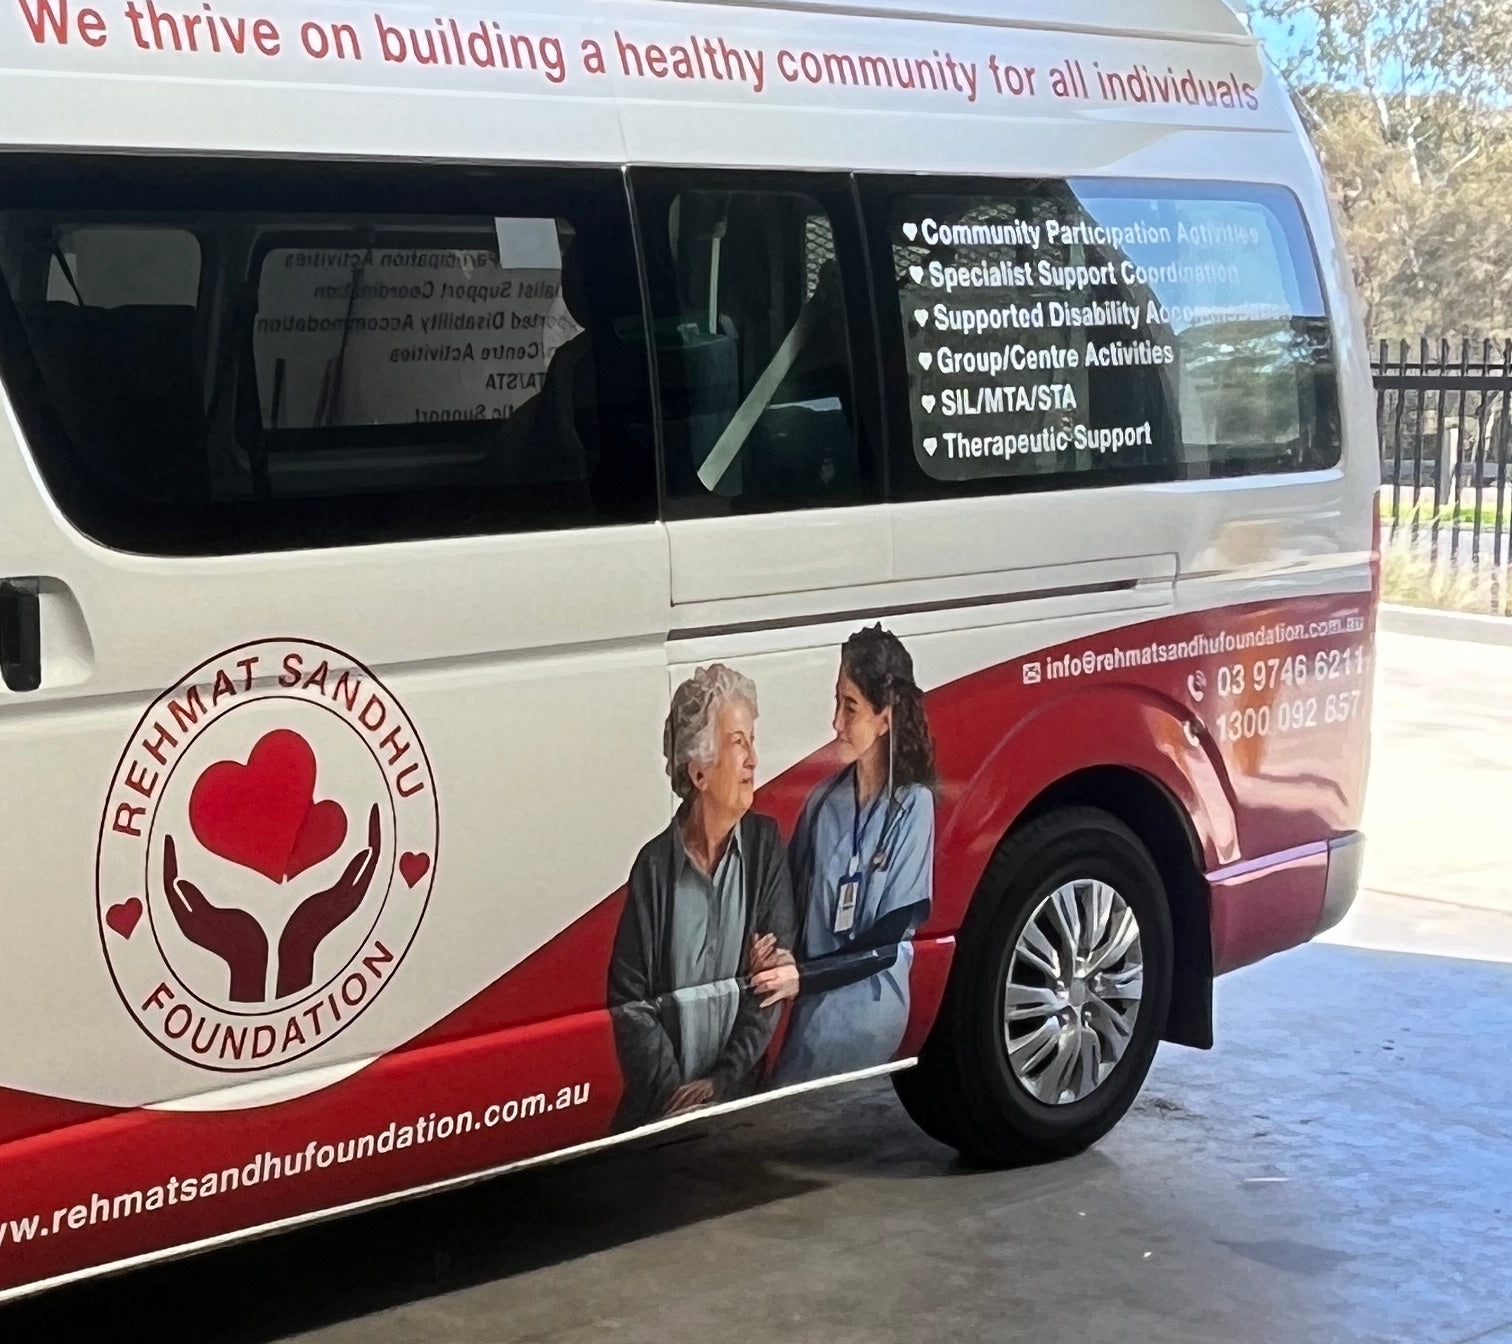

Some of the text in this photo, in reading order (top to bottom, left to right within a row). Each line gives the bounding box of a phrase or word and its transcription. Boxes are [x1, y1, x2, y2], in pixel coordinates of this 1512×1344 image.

[125, 0, 280, 57] thrive
[301, 18, 363, 61] on
[374, 13, 566, 84] building
[581, 37, 606, 75] a
[614, 30, 765, 93] healthy
[778, 43, 977, 102] community
[988, 54, 1036, 99] for
[1051, 60, 1089, 100] all
[1094, 61, 1260, 111] individuals
[921, 218, 1040, 249] Community
[1046, 219, 1171, 249] Participation
[928, 260, 1034, 293] Specialist
[1037, 260, 1118, 291] Support
[933, 302, 1044, 335] Supported
[1048, 300, 1139, 330] Disability
[937, 340, 1174, 376] Group/Centre Activities
[941, 383, 1077, 416] SIL/MTA/STA
[942, 421, 1152, 460] Therapeutic Support
[1046, 617, 1363, 680] info@rehmatsandhufoundation.com.au
[1217, 645, 1364, 697] 03 9746 6211
[1216, 706, 1270, 741] 1300
[1278, 698, 1317, 732] 092
[112, 653, 425, 837] REHMAT SANDHU
[142, 940, 395, 1060] FOUNDATION
